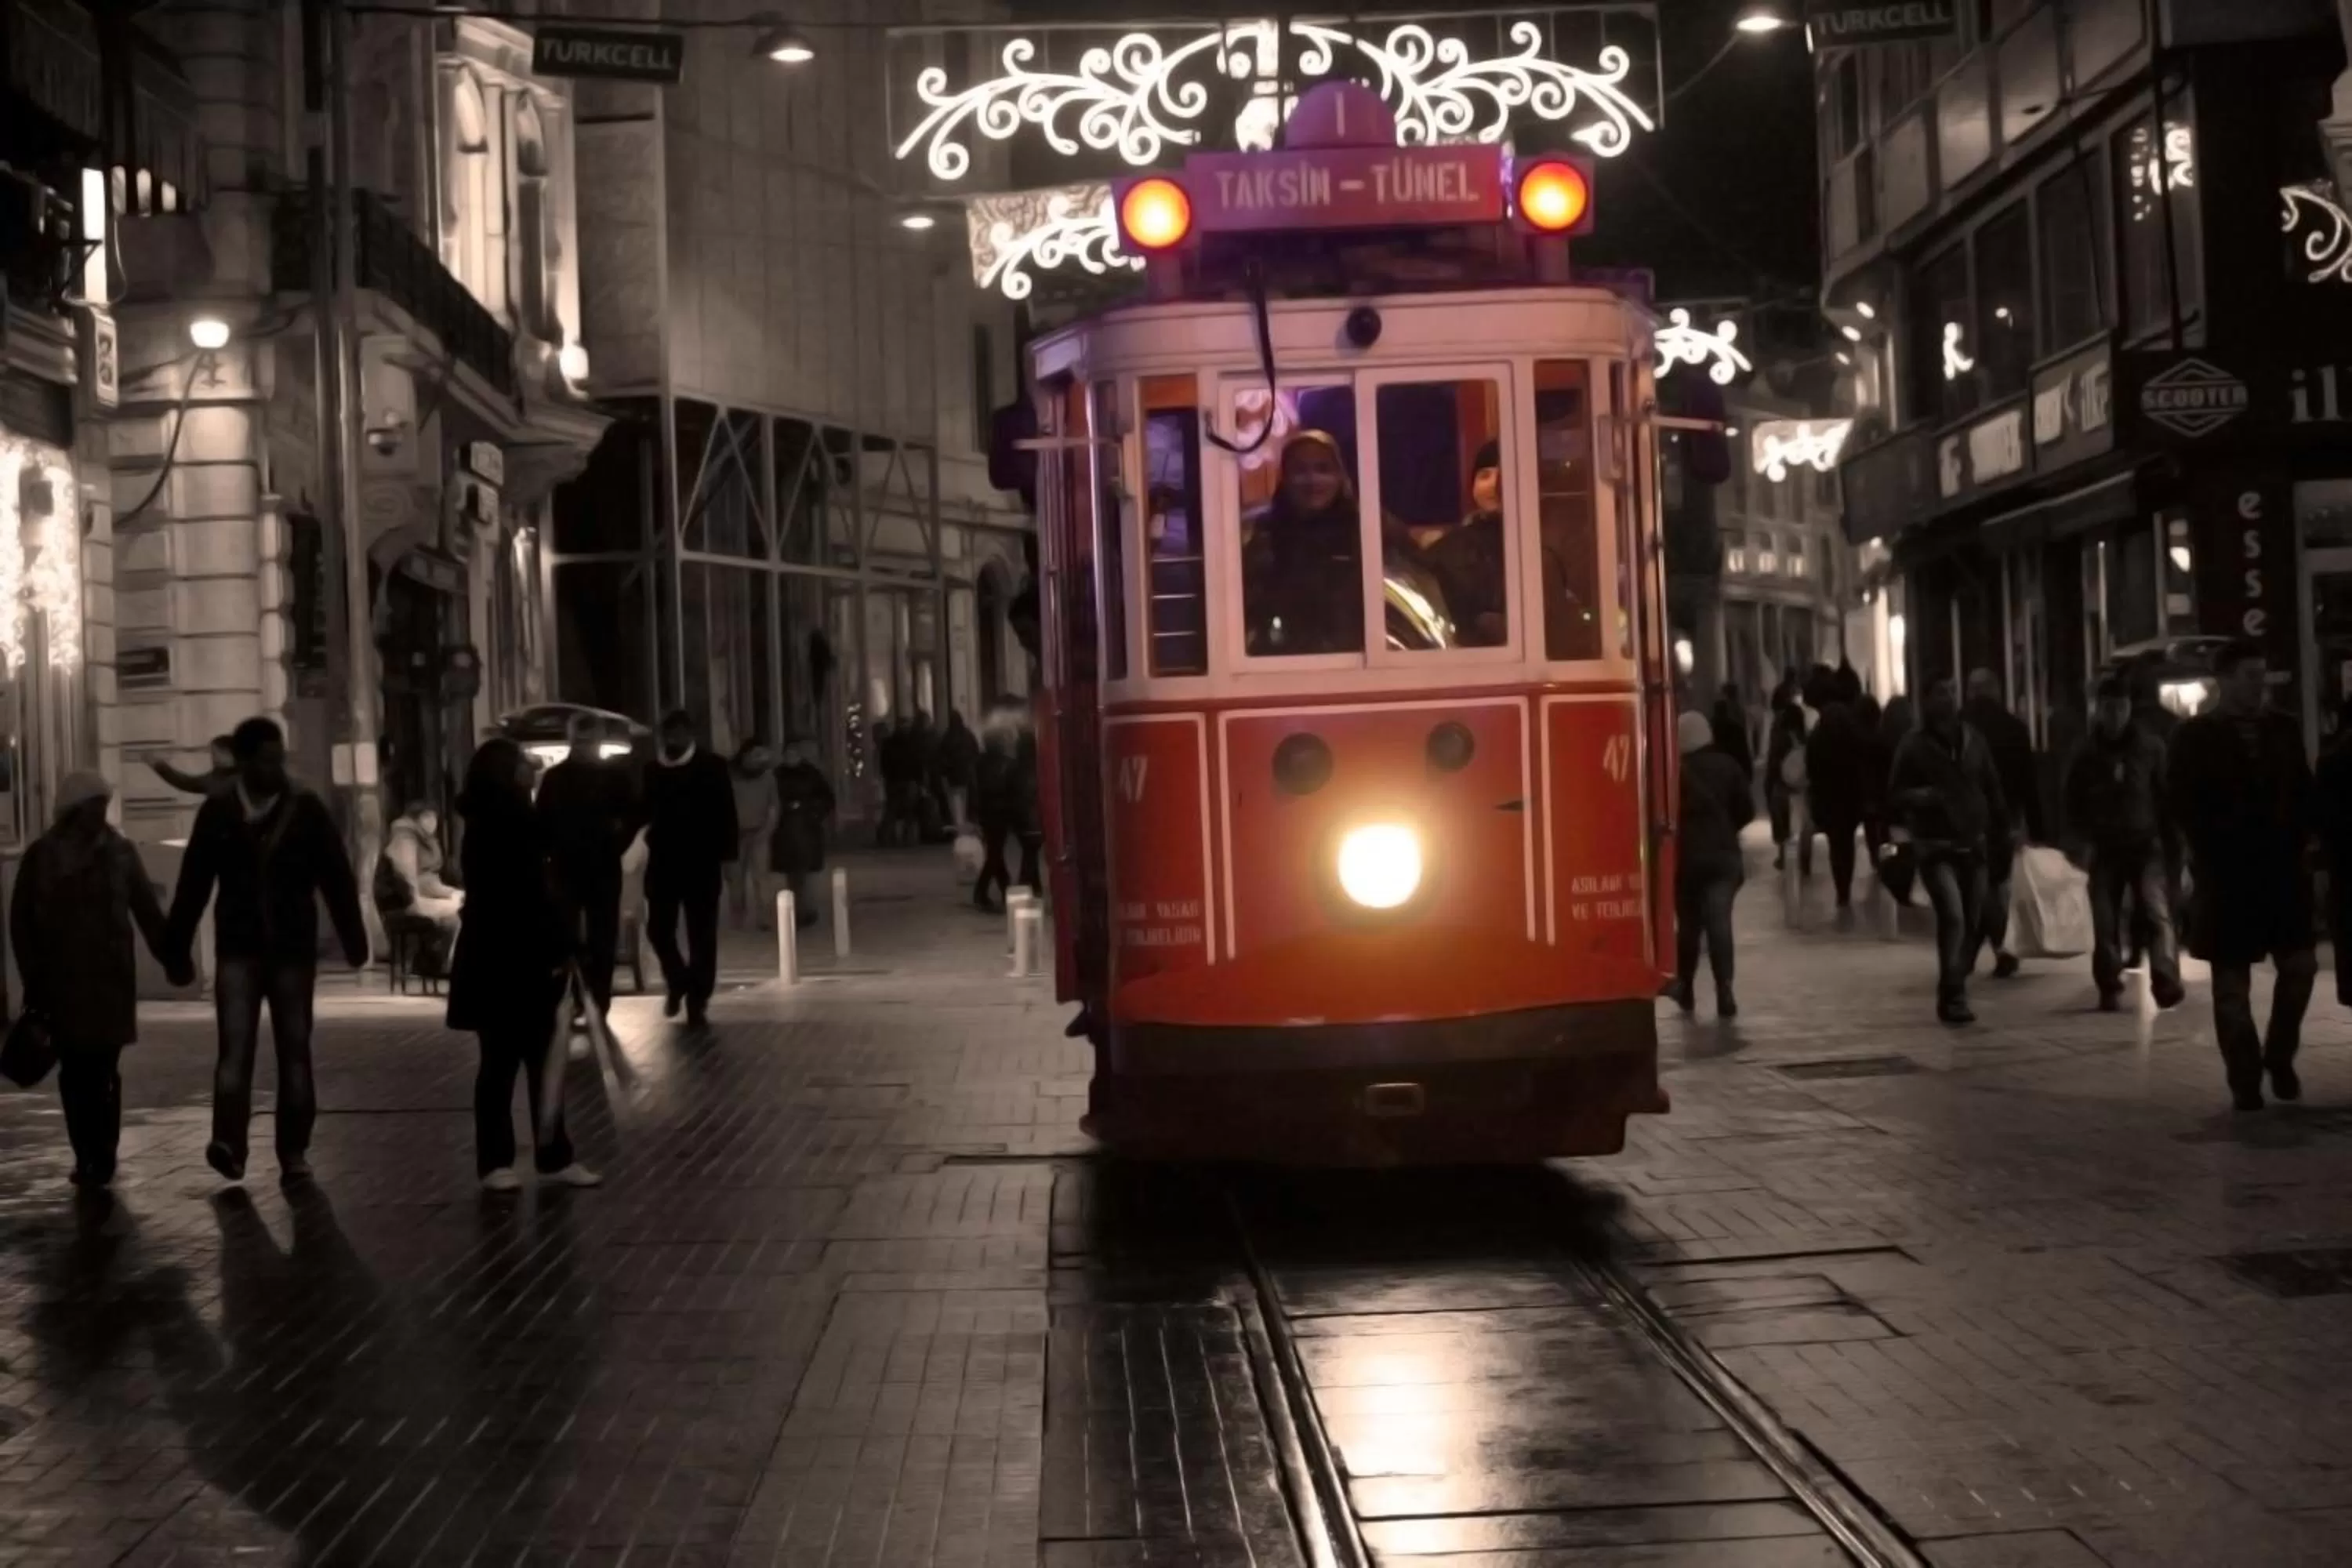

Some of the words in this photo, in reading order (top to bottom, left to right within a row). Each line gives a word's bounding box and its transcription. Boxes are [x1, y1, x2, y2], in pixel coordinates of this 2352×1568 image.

[1815, 2, 1954, 35] TURKCELL
[542, 39, 673, 71] TURKCELL
[2288, 363, 2352, 424] il
